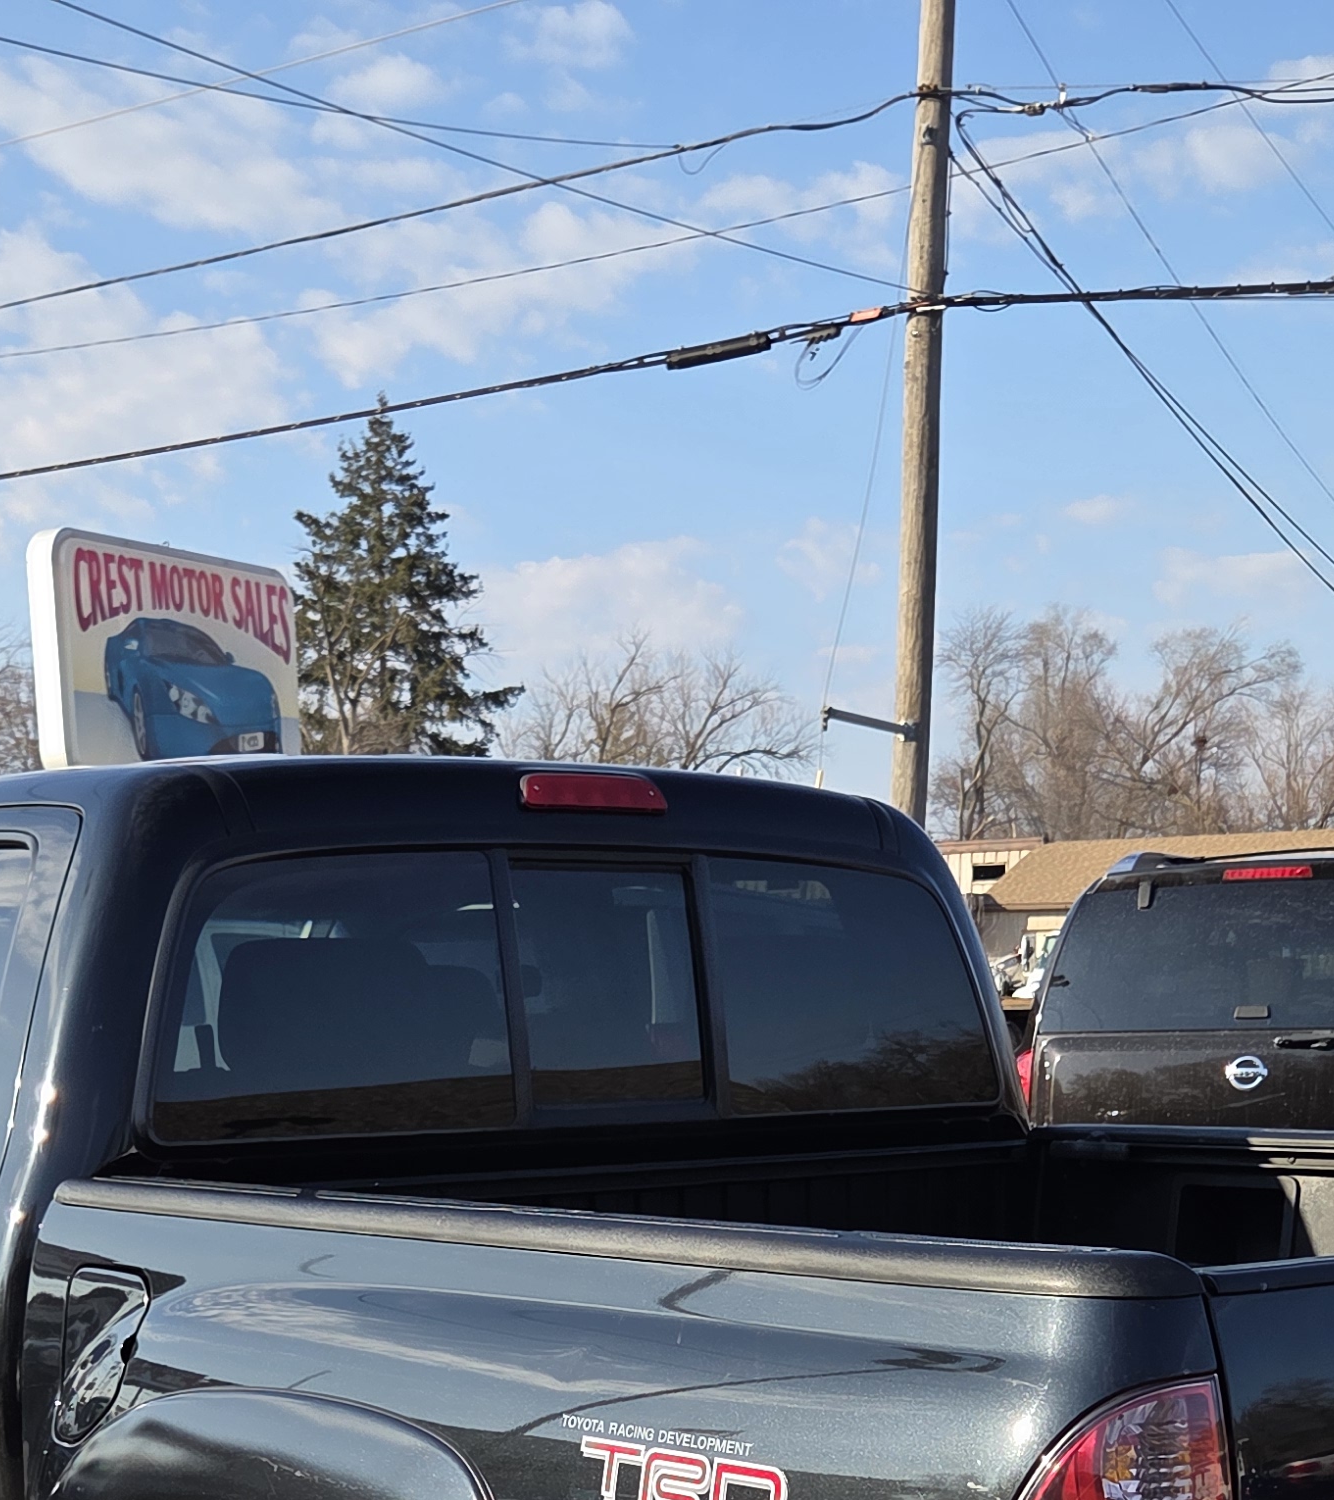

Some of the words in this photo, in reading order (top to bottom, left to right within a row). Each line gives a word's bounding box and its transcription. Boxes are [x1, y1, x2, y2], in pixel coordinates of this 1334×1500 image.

[73, 546, 145, 633] CREST
[148, 560, 229, 624] MOTOR
[230, 576, 292, 666] SALES
[562, 1413, 604, 1433] TOYOTA
[608, 1422, 655, 1442] RACING
[657, 1430, 755, 1457] DEVELOPMENT
